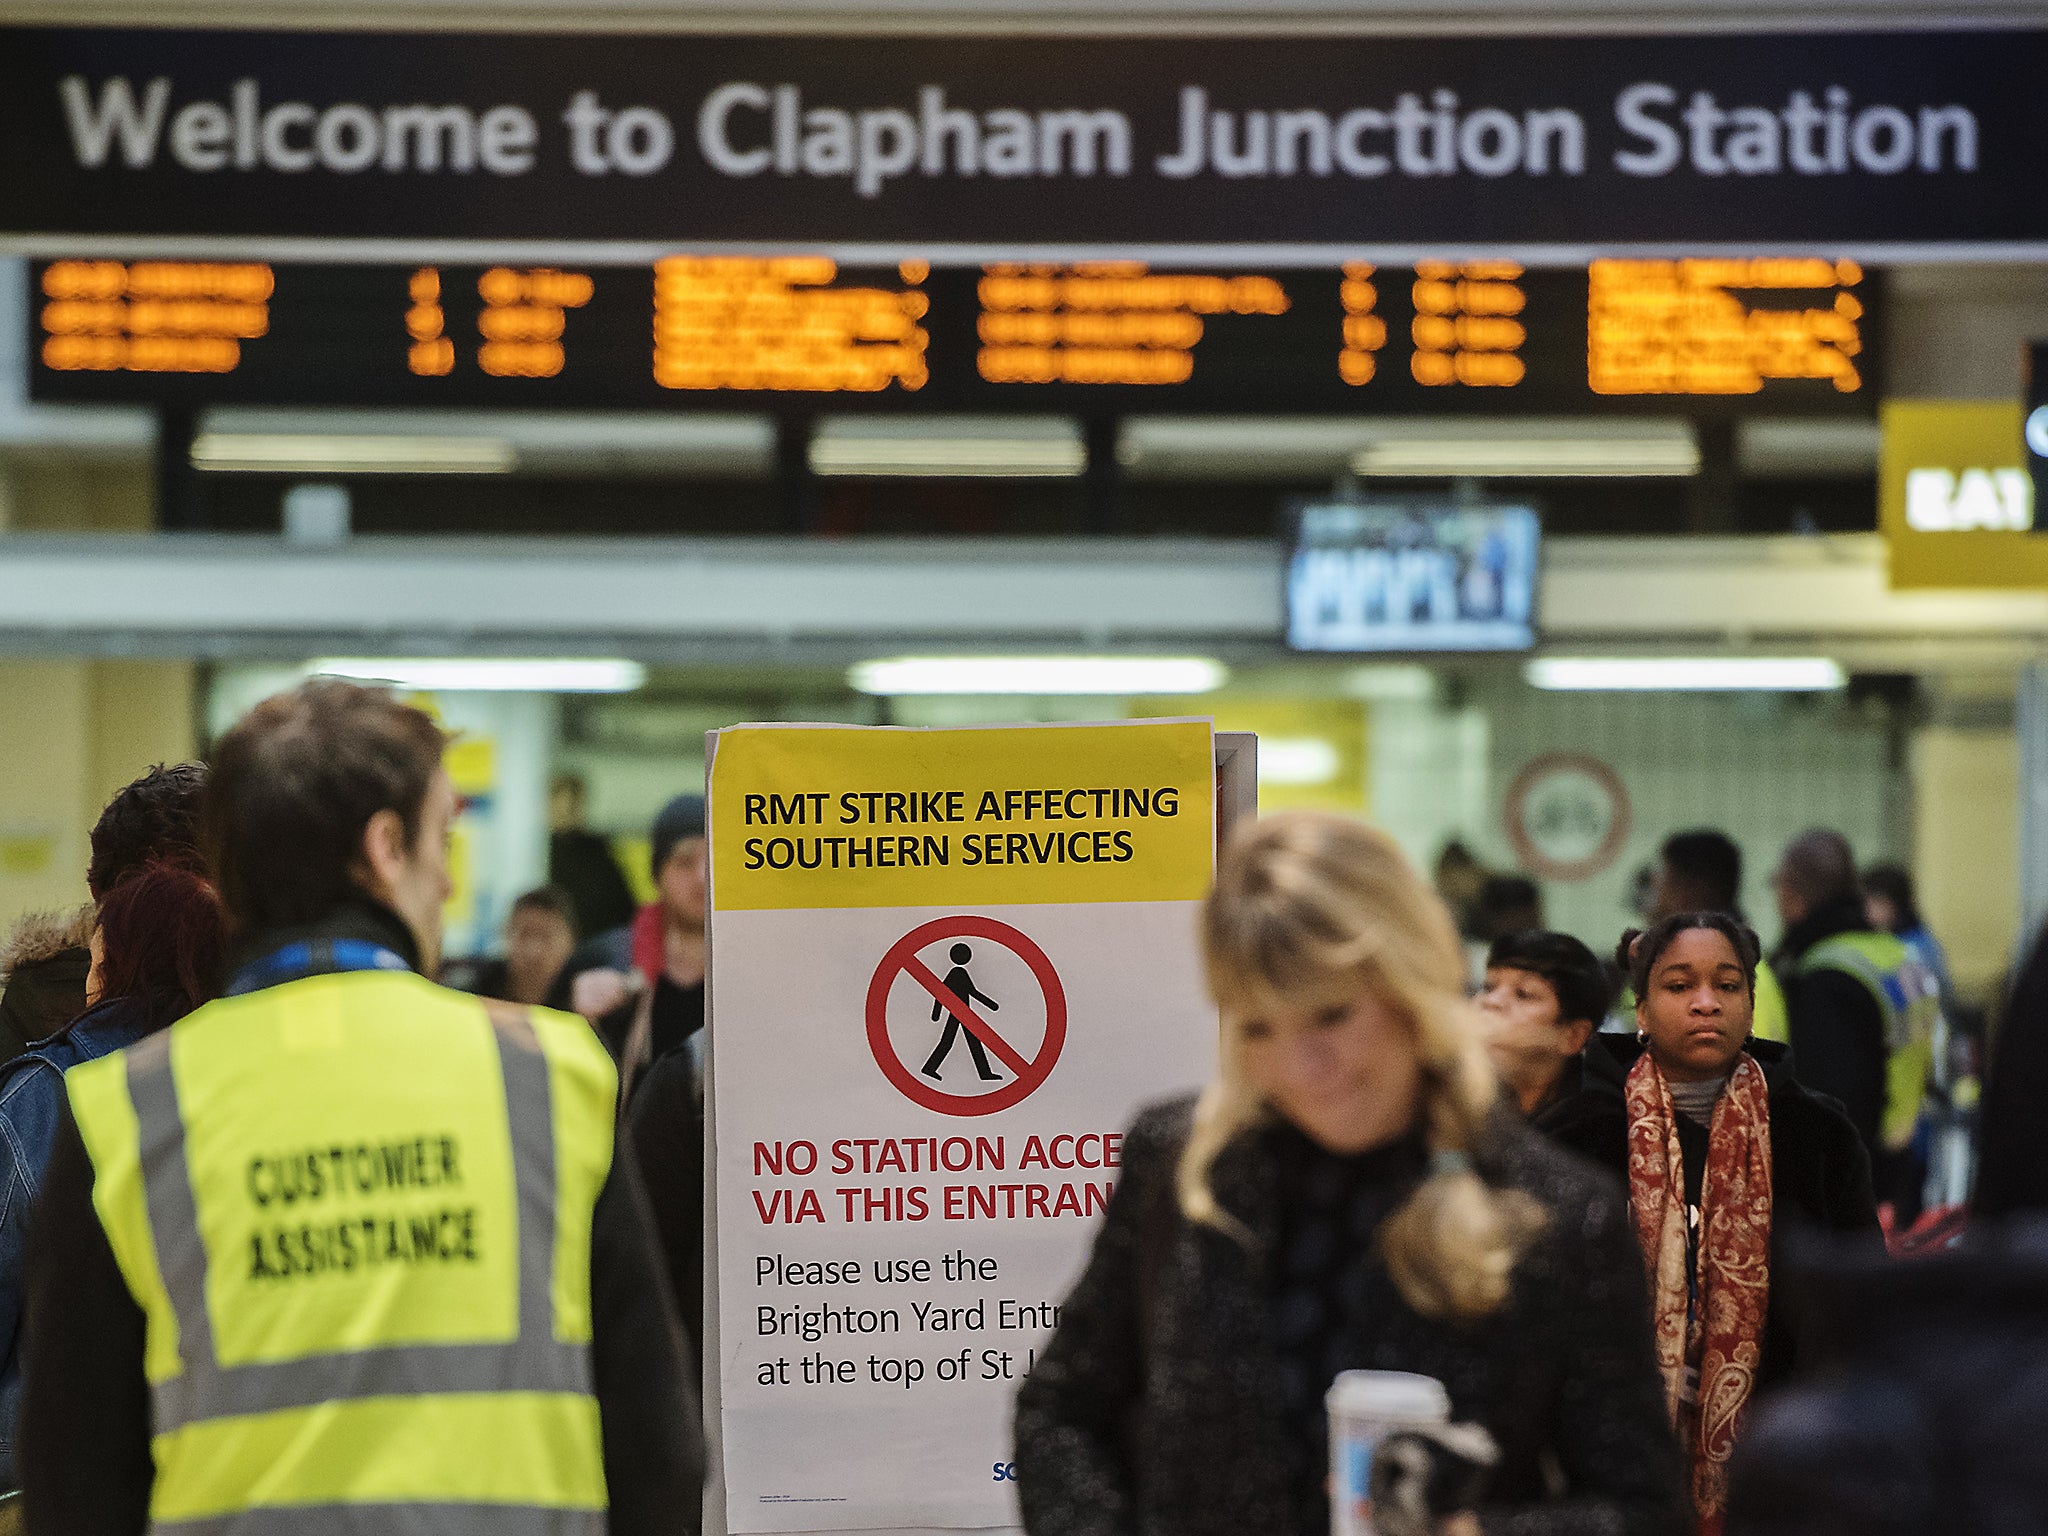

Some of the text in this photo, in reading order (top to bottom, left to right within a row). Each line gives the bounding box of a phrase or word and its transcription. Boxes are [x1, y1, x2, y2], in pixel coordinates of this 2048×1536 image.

[60, 76, 1979, 197] Welcome to Clapham Junction Station
[744, 787, 1179, 825] RMT STRIKE AFFECTING
[744, 830, 1134, 870] SOUTHERN SERVICES
[249, 1135, 462, 1206] CUSTOMER
[753, 1133, 1124, 1176] NO STATION ACCE
[752, 1181, 1111, 1224] VIA THIS ENTRAN
[248, 1207, 481, 1279] ASSISTANCE
[755, 1250, 998, 1286] Please use the
[757, 1299, 1063, 1342] Brighton Yard Entr
[757, 1357, 789, 1386] at
[800, 1353, 856, 1383] the
[867, 1352, 925, 1389] top
[937, 1349, 971, 1380] of
[981, 1350, 1014, 1379] St
